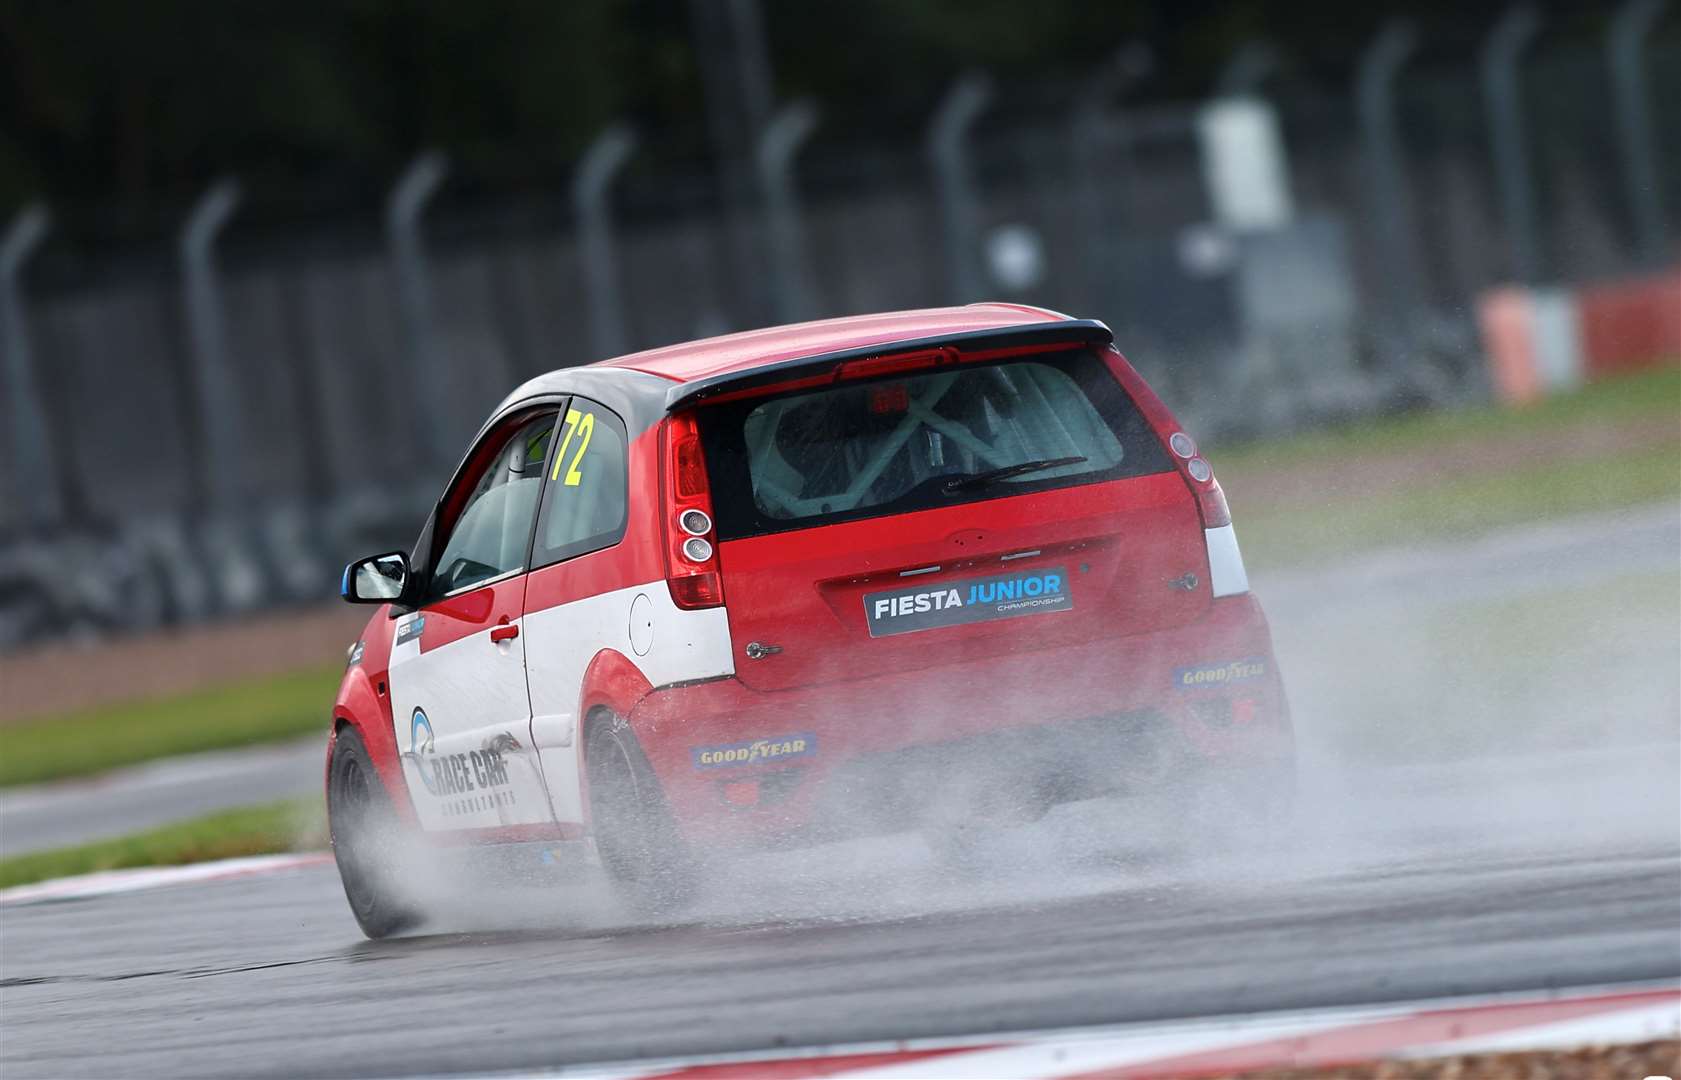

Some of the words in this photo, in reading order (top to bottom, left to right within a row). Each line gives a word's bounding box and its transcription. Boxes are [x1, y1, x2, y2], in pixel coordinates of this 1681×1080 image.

[552, 408, 595, 486] 72
[875, 589, 962, 620] FIESTA
[967, 574, 1061, 606] JUNIOR
[997, 597, 1065, 612] CHAMPIONSHIP
[431, 753, 475, 797] RACE
[469, 749, 509, 789] CAR
[700, 739, 806, 764] GOODYEAR
